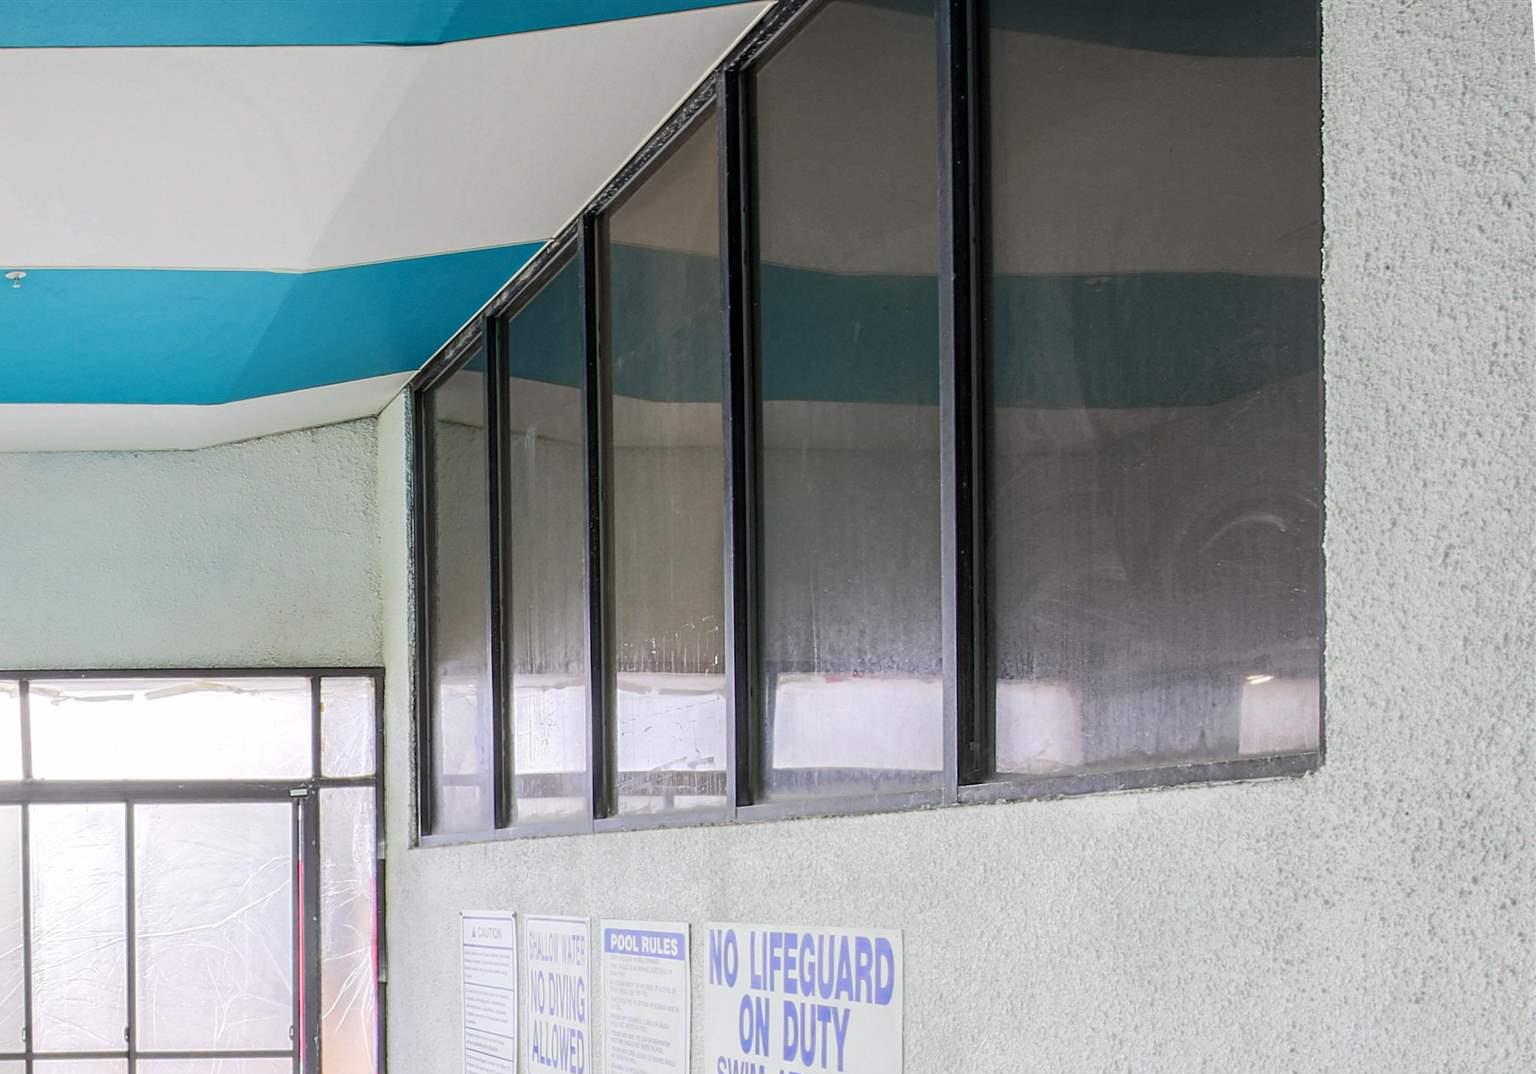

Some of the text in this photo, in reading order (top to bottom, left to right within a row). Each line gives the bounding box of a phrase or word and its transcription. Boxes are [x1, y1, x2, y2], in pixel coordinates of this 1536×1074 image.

[561, 933, 585, 966] WATER
[610, 933, 678, 956] POOL RULES
[709, 928, 895, 1006] NO LIFEGUARD
[530, 969, 585, 1024] NO DIVING
[739, 994, 851, 1073] ON DUTY
